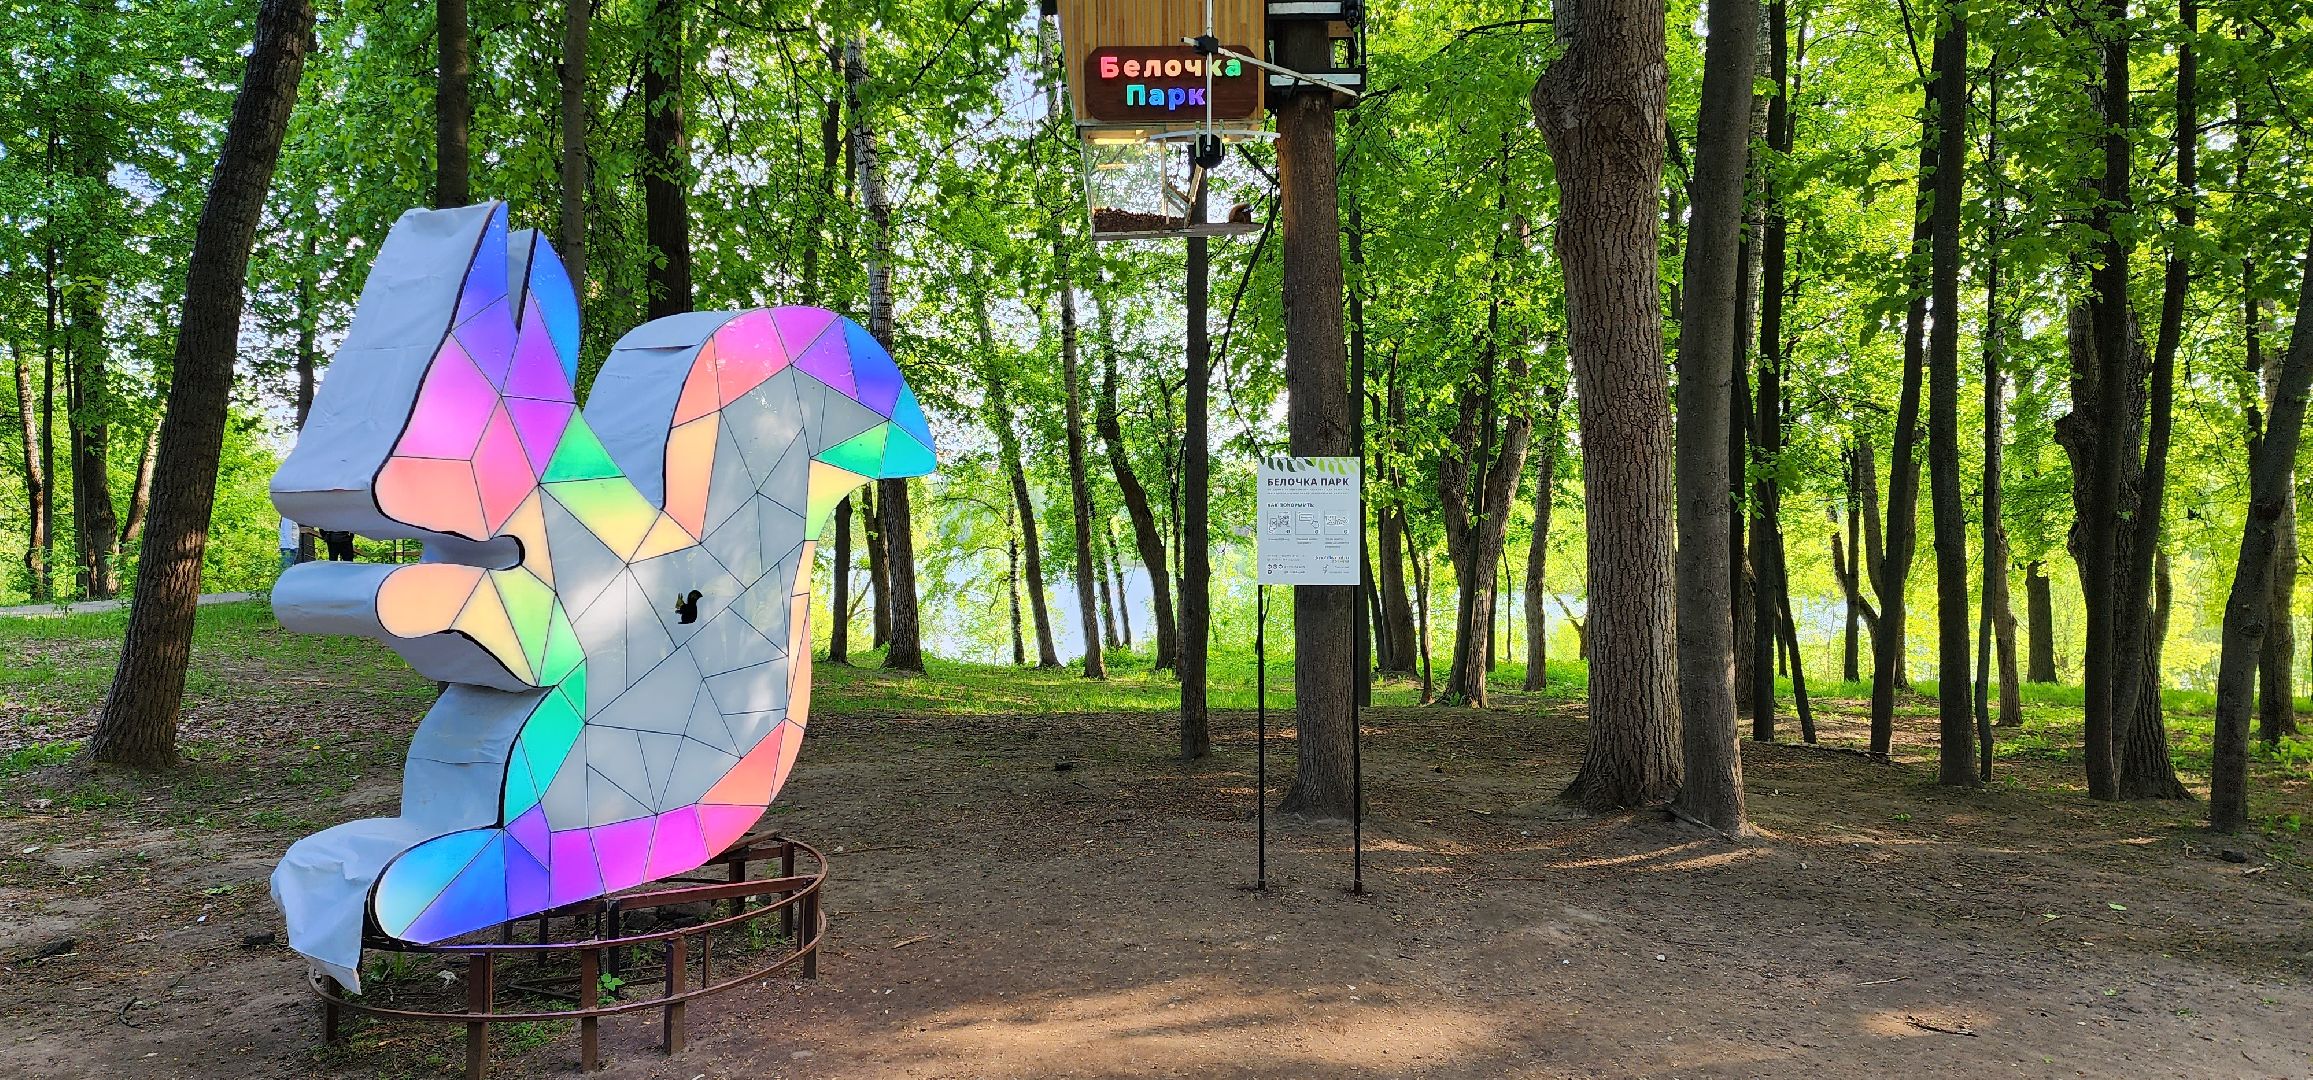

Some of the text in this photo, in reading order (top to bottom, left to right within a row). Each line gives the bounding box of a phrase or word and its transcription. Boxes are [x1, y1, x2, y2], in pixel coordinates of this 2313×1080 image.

[1100, 56, 1242, 78] Белочка
[1126, 84, 1207, 111] Парк
[1267, 477, 1350, 487] БЕЛОЧКА ПАРК
